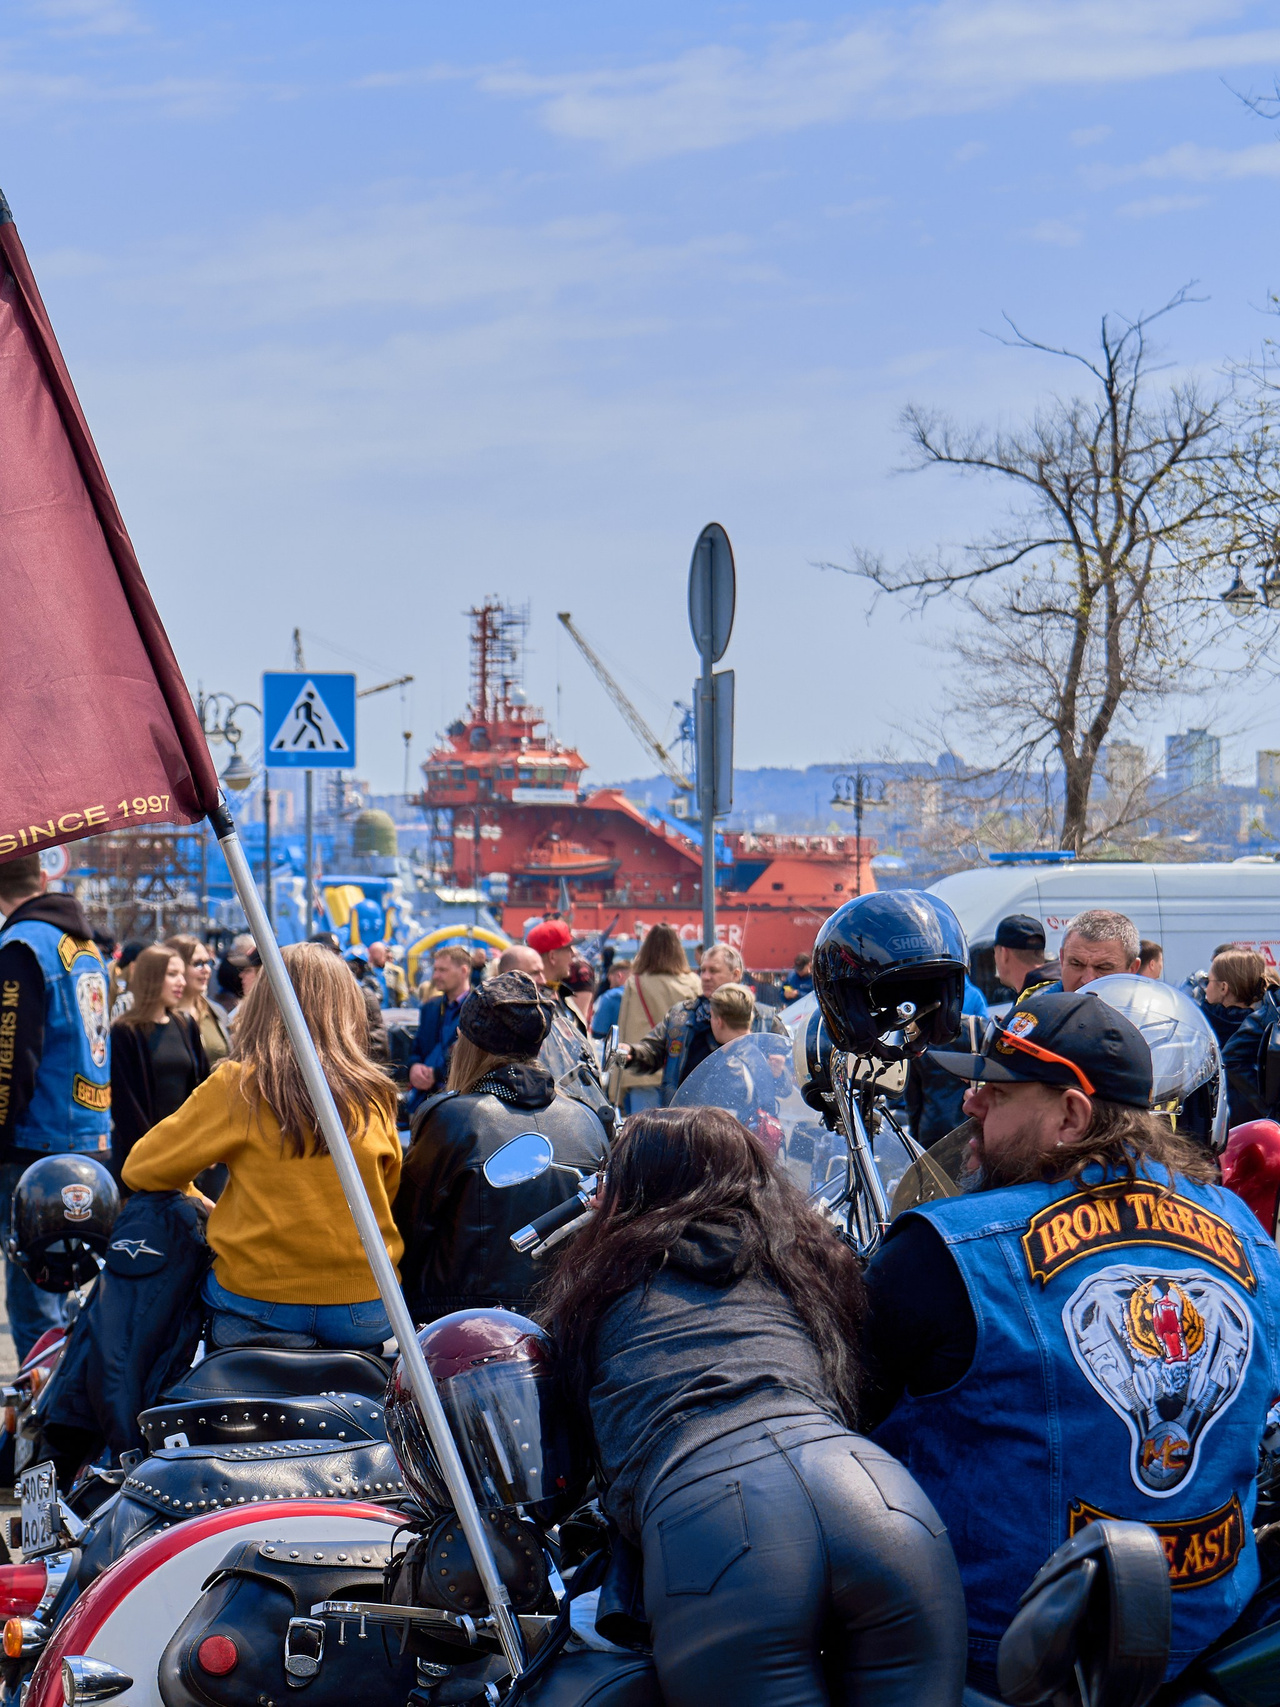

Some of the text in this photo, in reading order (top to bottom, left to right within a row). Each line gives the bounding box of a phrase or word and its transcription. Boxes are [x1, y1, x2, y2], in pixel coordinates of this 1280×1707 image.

[117, 794, 170, 818] 1997
[2, 980, 20, 1008] MC
[1036, 1192, 1242, 1269] IRON TIGERS
[1142, 1435, 1190, 1470] MC
